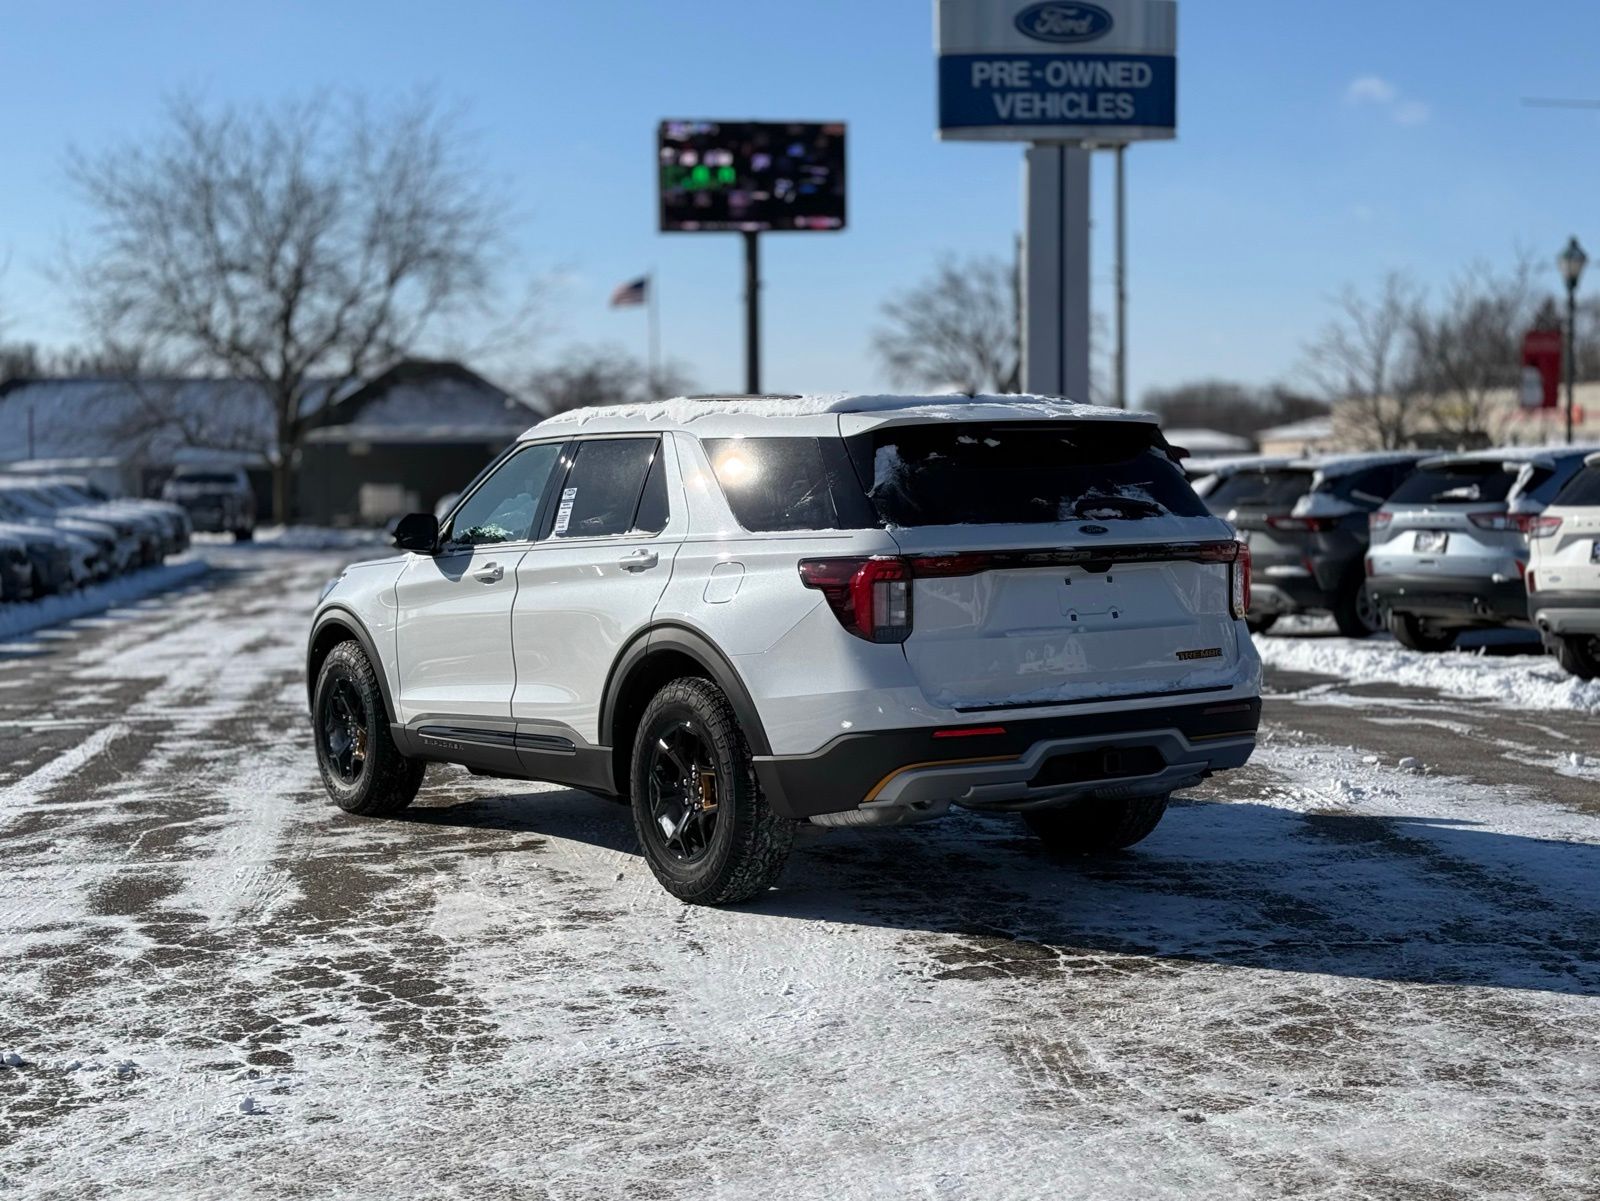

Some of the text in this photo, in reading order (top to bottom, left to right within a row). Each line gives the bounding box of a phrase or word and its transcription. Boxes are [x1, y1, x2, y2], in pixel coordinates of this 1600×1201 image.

[1034, 4, 1093, 34] Ford
[971, 61, 1153, 89] PRE-OWNED
[992, 92, 1135, 119] VEHICLES
